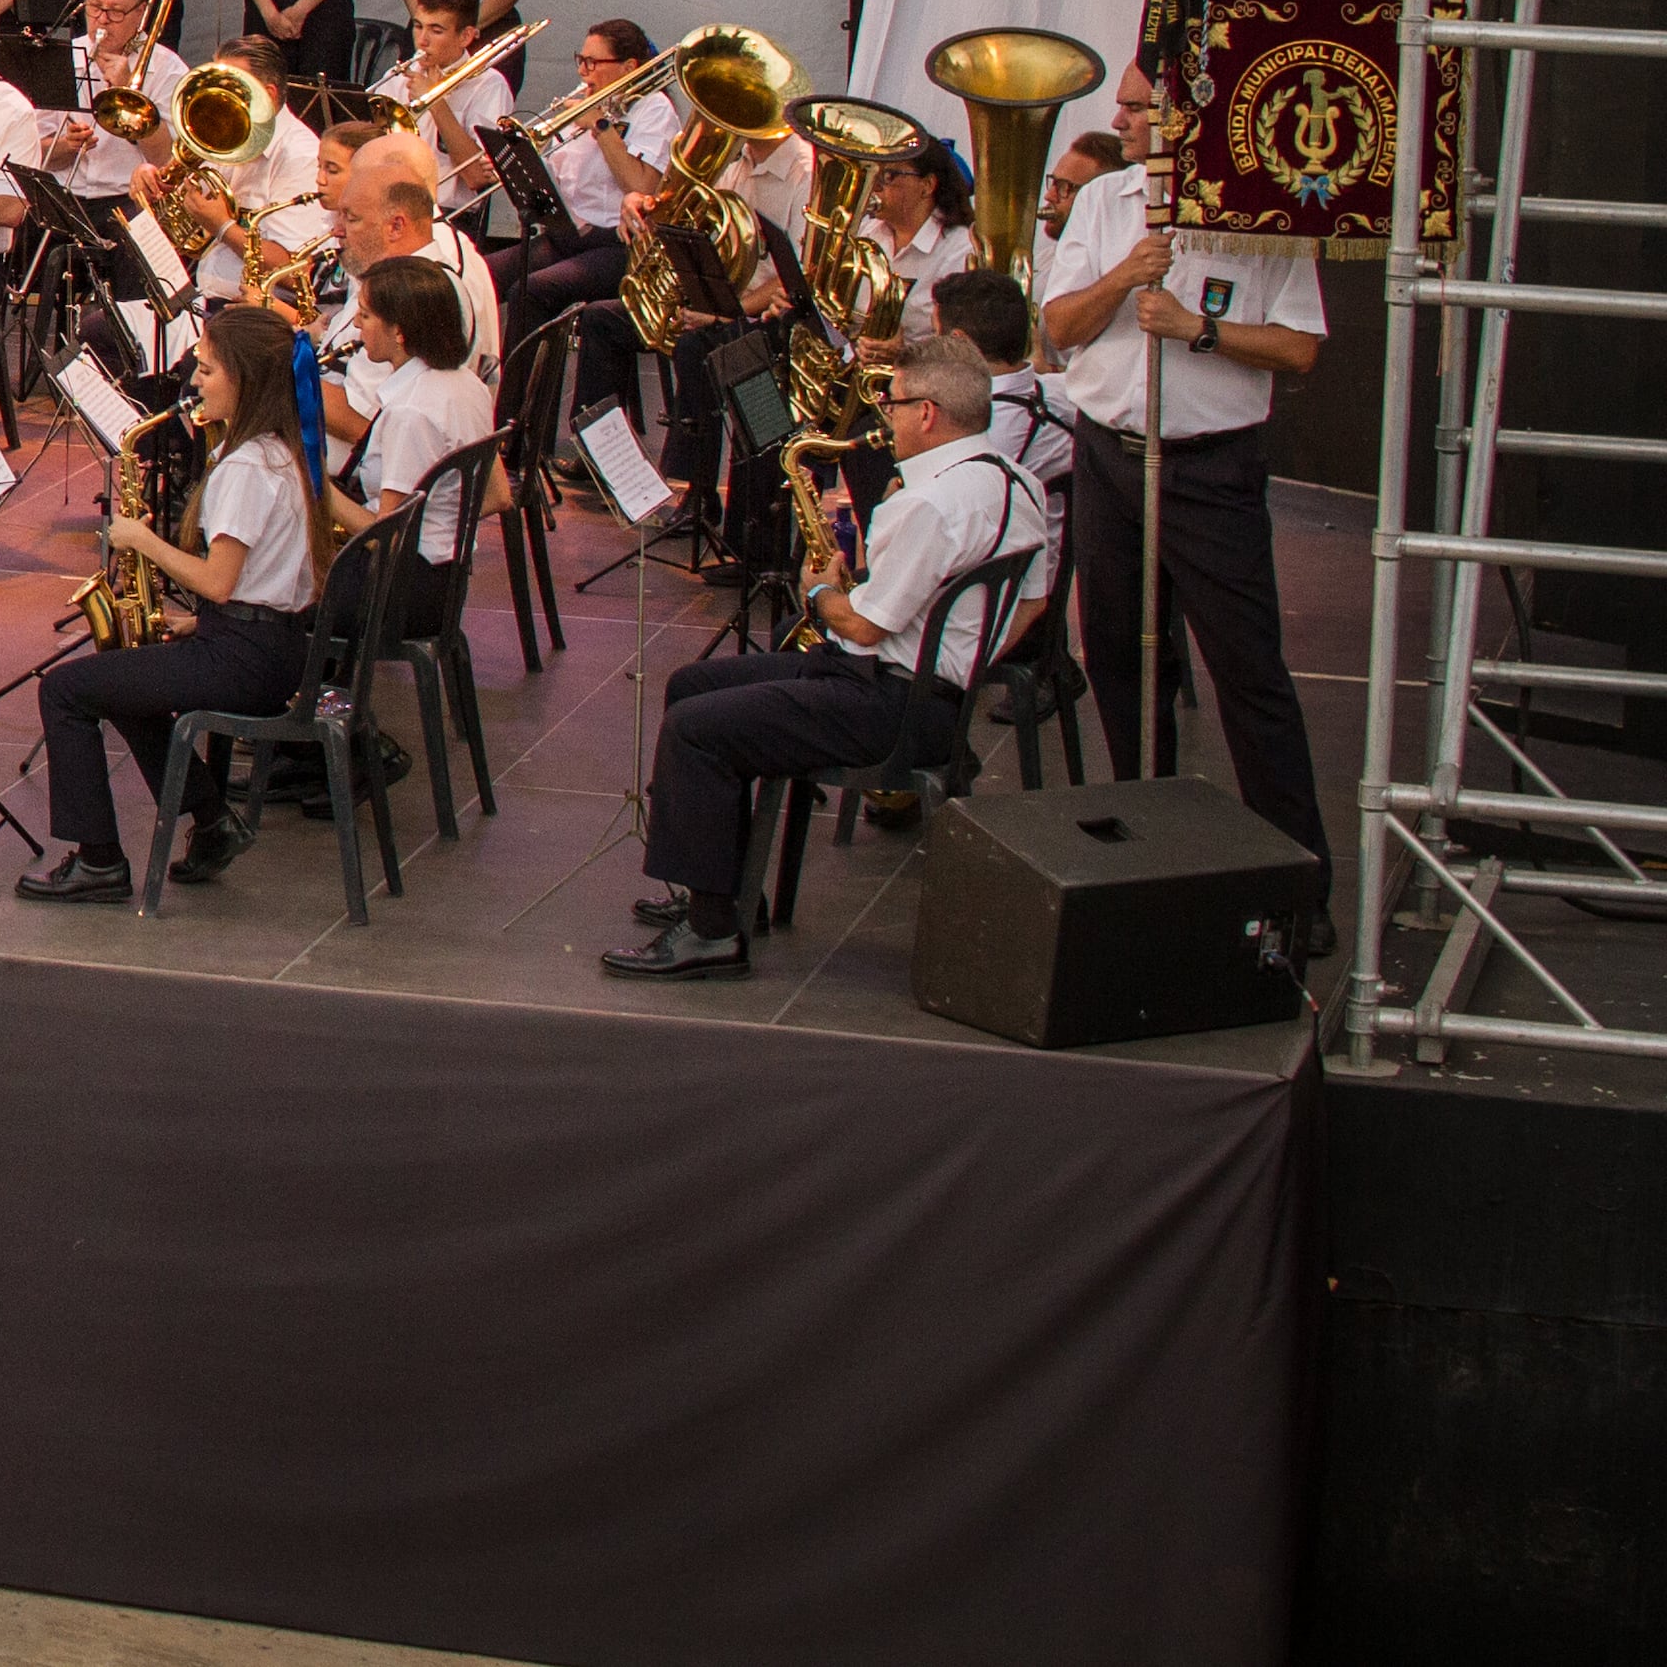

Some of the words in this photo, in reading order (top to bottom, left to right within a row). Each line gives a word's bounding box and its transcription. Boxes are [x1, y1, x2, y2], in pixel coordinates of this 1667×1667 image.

[1144, 5, 1163, 43] HAZTE
[1240, 45, 1329, 100] MUNICIPAL
[1232, 103, 1251, 168] BANDA
[1332, 48, 1398, 178] BENALMADENA
